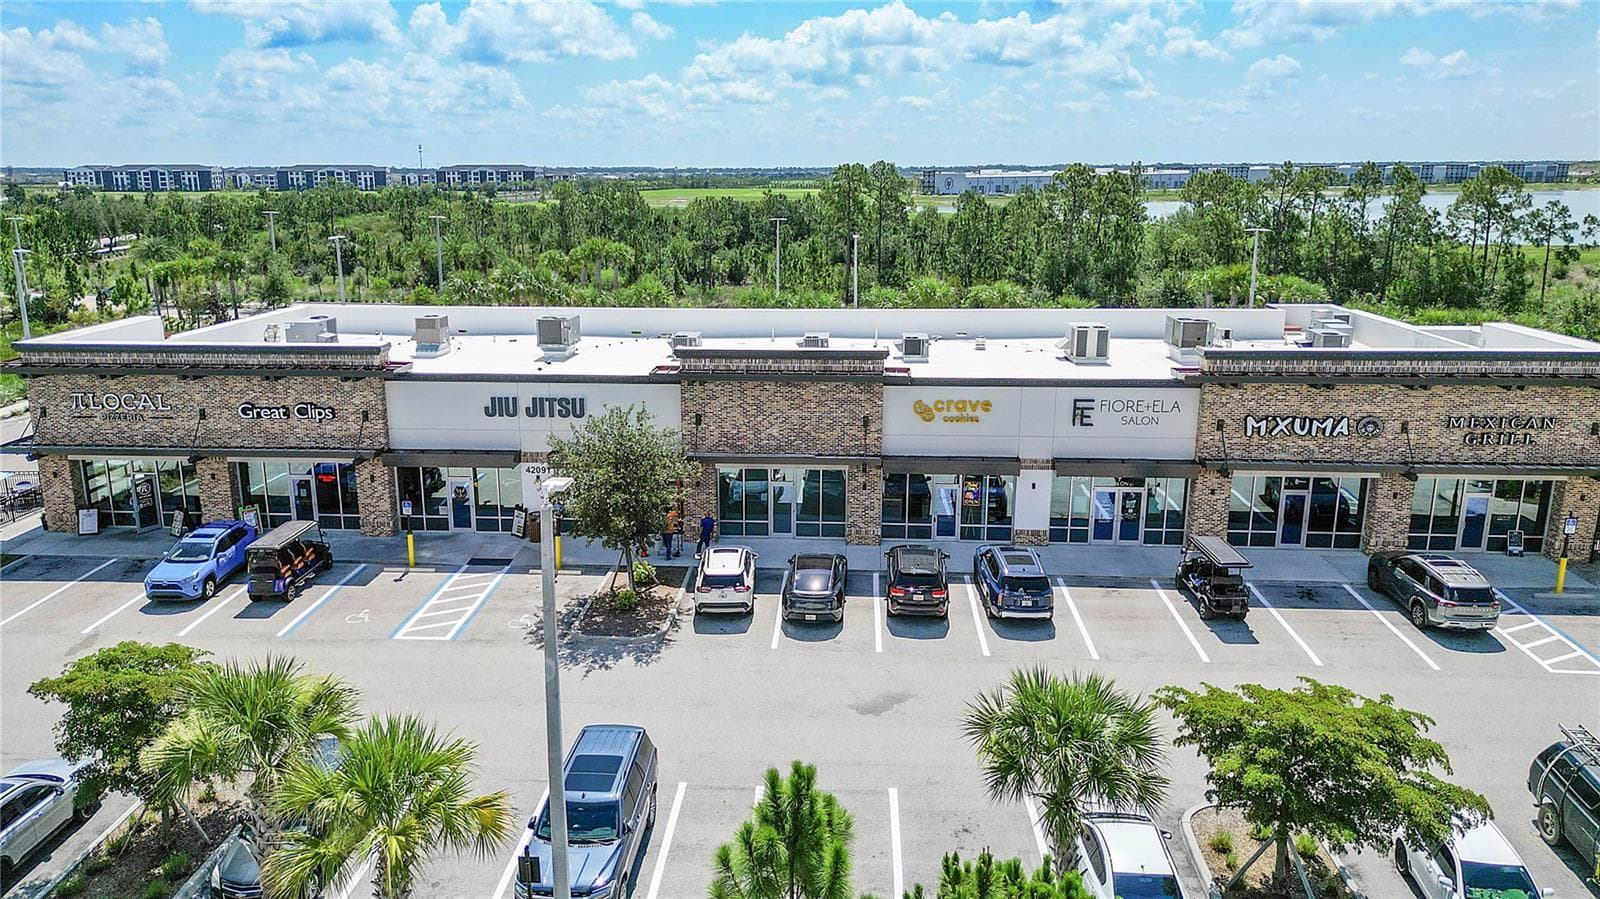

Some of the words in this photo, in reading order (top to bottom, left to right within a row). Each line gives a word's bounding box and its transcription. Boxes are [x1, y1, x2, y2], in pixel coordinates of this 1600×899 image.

[238, 402, 289, 419] Great
[294, 402, 335, 423] Clips
[483, 396, 518, 418] JIU
[525, 396, 586, 419] JITSU
[933, 399, 993, 413] crave
[1100, 399, 1181, 413] FIORE+ELA
[101, 412, 145, 422] PIZZERIA
[1120, 415, 1160, 426] SALON
[1447, 416, 1557, 429] MEXICAN
[1464, 432, 1537, 446] GRILL
